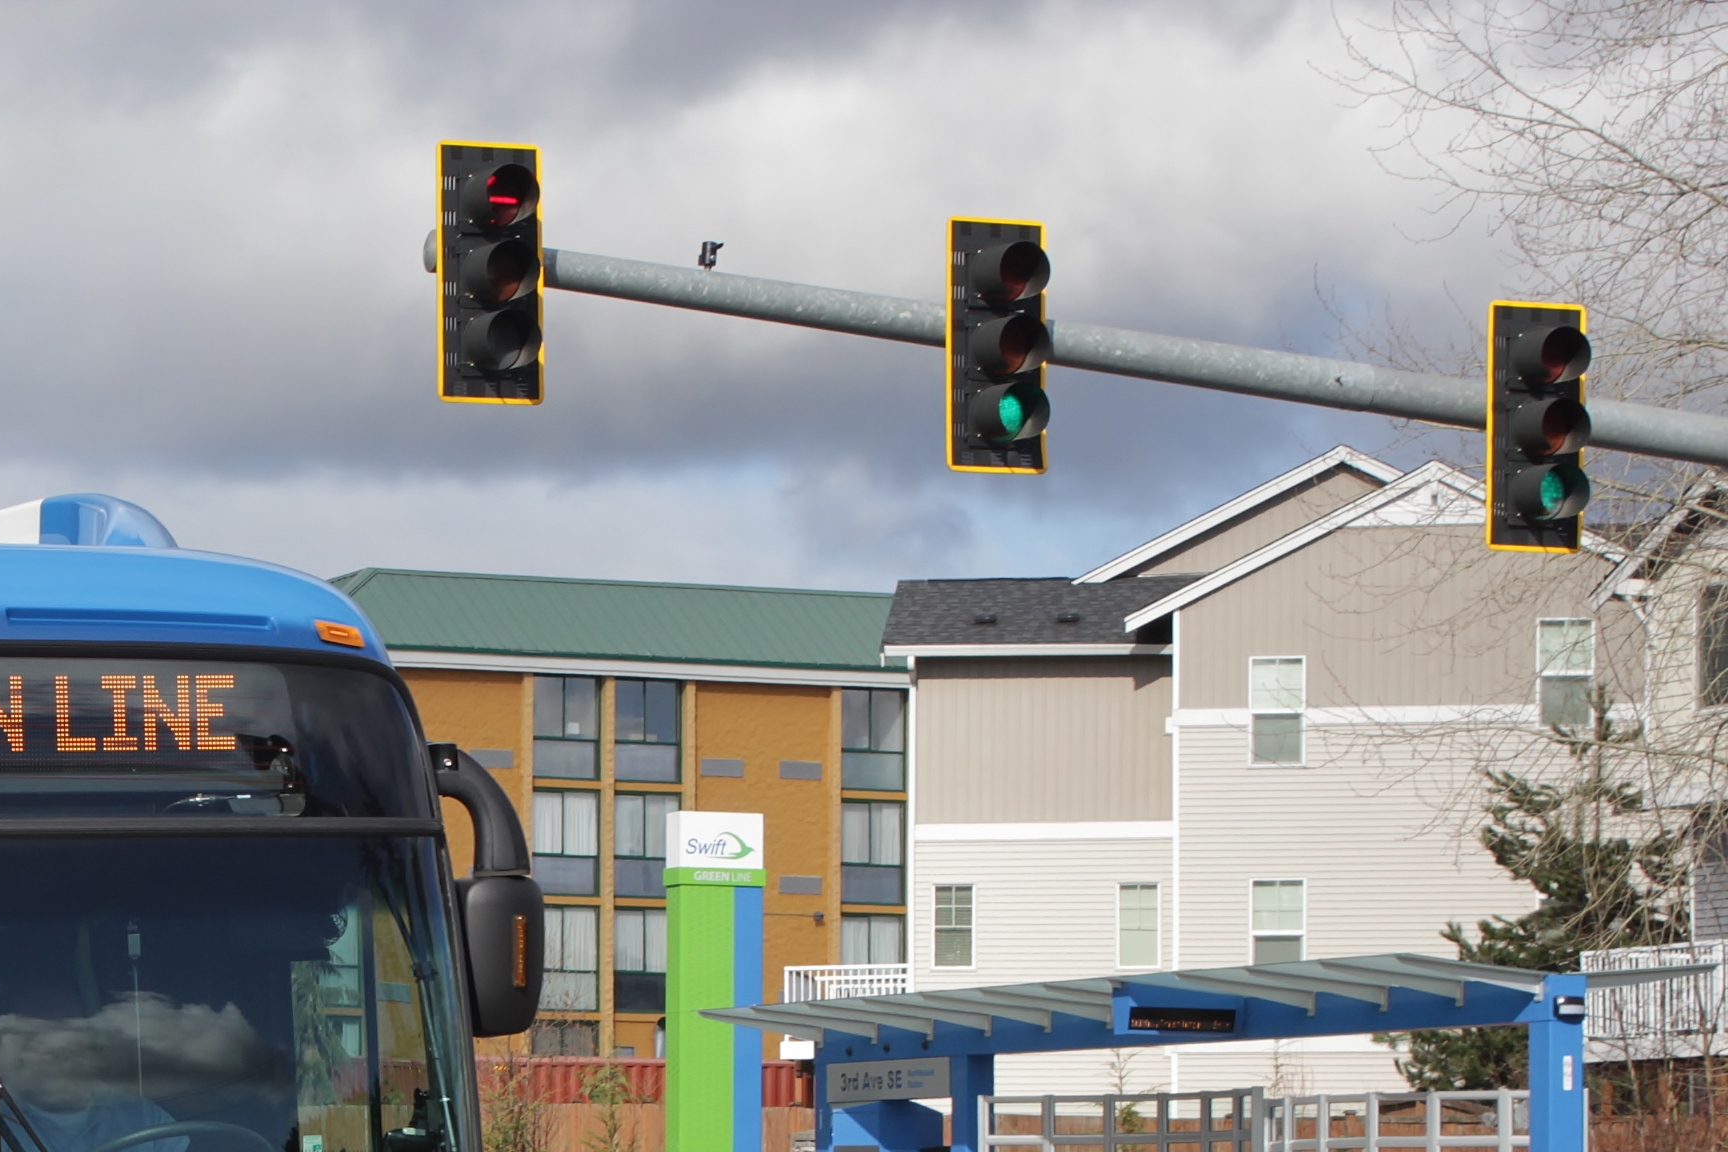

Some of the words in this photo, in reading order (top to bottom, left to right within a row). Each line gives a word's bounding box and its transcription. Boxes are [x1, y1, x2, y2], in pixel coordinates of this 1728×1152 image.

[54, 673, 237, 753] LINE
[685, 838, 727, 855] Swift
[693, 870, 730, 882] GREEN
[731, 871, 753, 882] LINE
[840, 1072, 859, 1092] 3rd
[863, 1072, 883, 1090] Ave
[887, 1070, 902, 1089] SE
